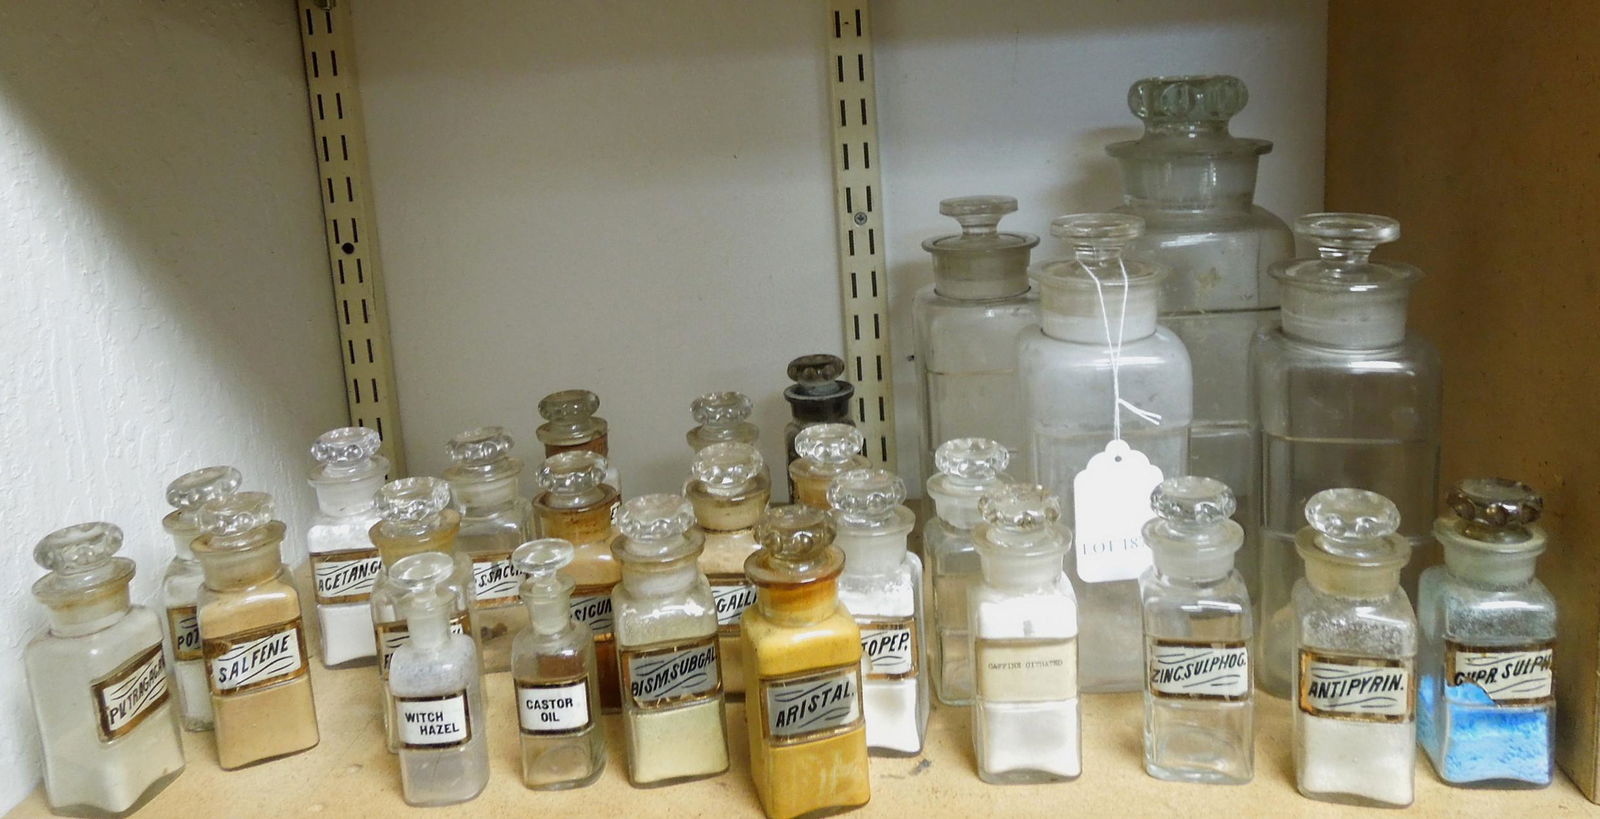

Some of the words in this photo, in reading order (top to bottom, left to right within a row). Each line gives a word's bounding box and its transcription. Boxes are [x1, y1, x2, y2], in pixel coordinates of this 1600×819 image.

[218, 634, 290, 683] SALFENE
[1308, 674, 1405, 699] ANTIPYRIN.
[526, 697, 574, 710] CASTOR
[775, 681, 855, 728] ARISTAL.
[405, 711, 444, 723] WITCH
[541, 711, 561, 722] OIL
[420, 722, 460, 735] HAZEL
